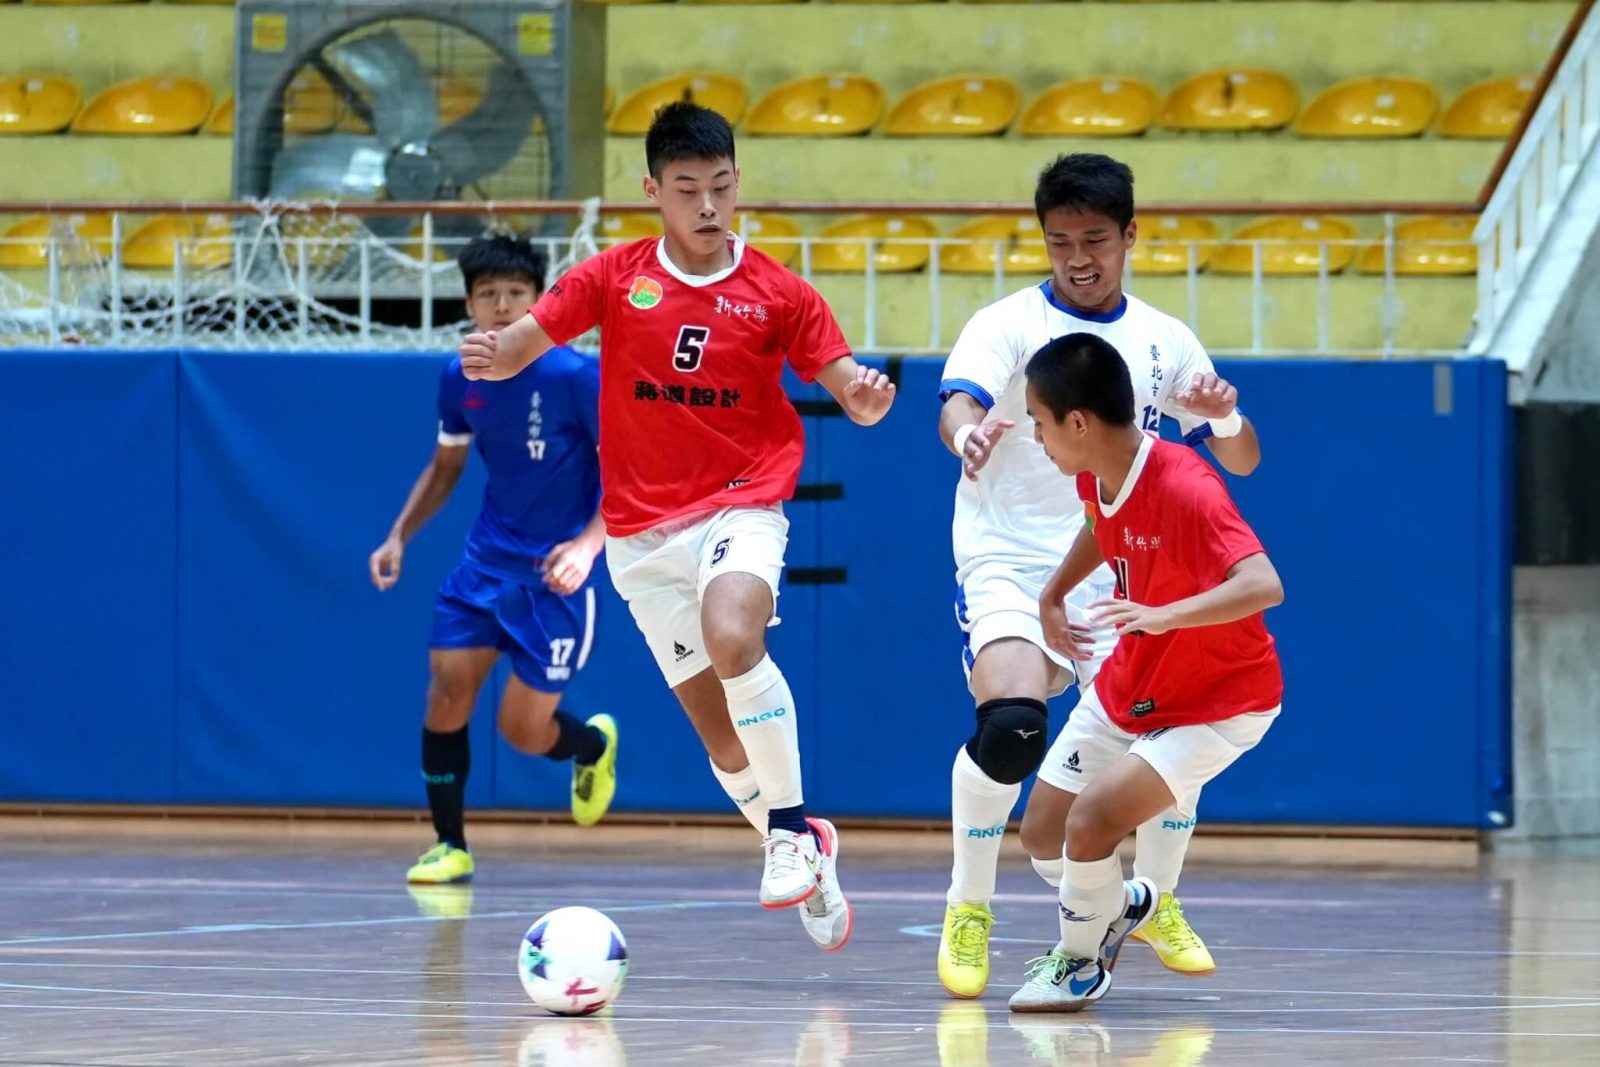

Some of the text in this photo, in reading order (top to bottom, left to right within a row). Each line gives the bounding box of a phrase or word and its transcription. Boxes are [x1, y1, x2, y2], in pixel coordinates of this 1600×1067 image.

[672, 325, 710, 372] 5
[1142, 405, 1159, 432] 12
[526, 439, 546, 460] 17
[710, 536, 734, 568] 5
[549, 637, 575, 666] 17
[737, 708, 786, 727] ANGO
